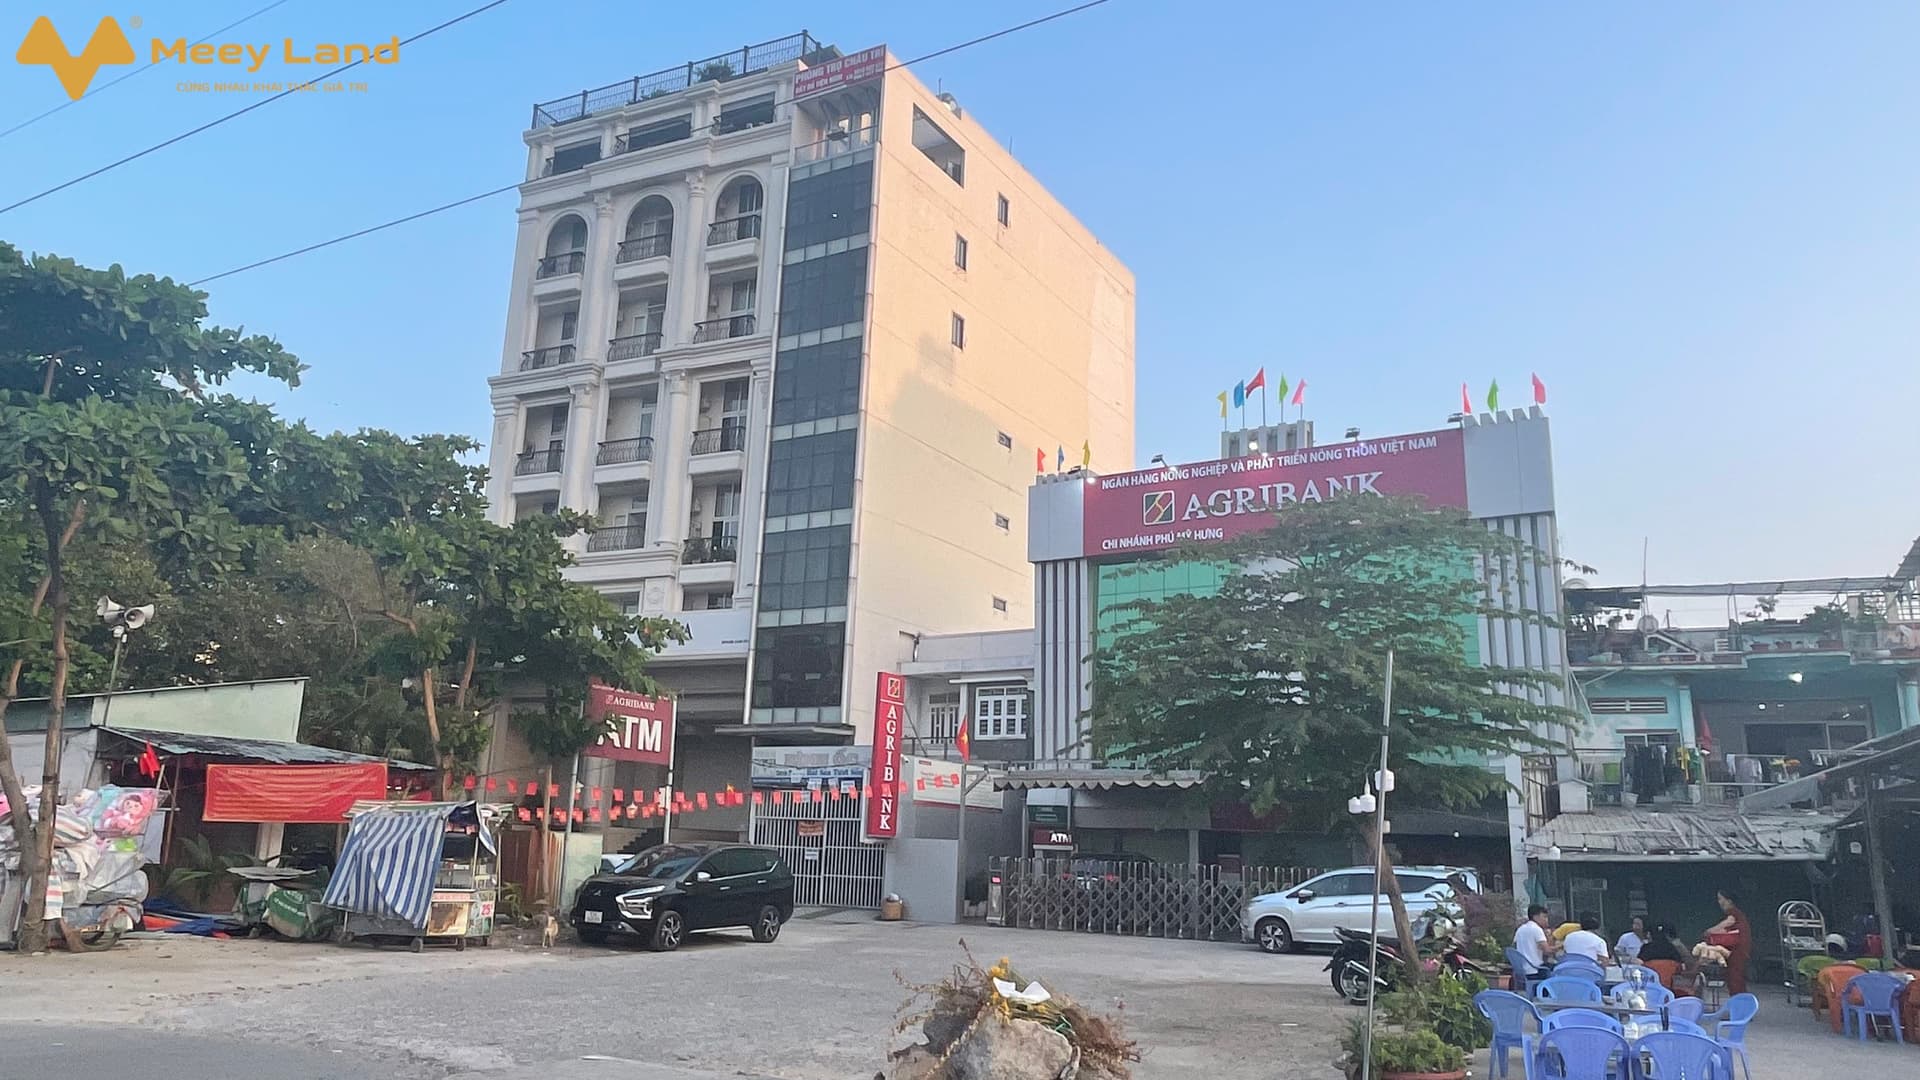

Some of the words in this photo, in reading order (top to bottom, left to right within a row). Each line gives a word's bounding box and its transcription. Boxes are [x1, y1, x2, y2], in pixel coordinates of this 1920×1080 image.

[1102, 477, 1129, 490] NGÂN
[1131, 473, 1159, 486] HÀNG
[1191, 462, 1228, 478] NGHIỆP
[1231, 461, 1245, 473] VÀ
[1310, 448, 1343, 463] NÔNG
[1380, 439, 1406, 455] VIỆT
[1408, 436, 1437, 450] NAM
[1181, 471, 1384, 521] AGRIBANK
[1102, 539, 1118, 550] CHI
[1119, 534, 1153, 549] NHÁNH
[1155, 531, 1175, 544] PHÚ
[613, 697, 655, 712] AGRIBANK
[1050, 833, 1072, 843] ATM
